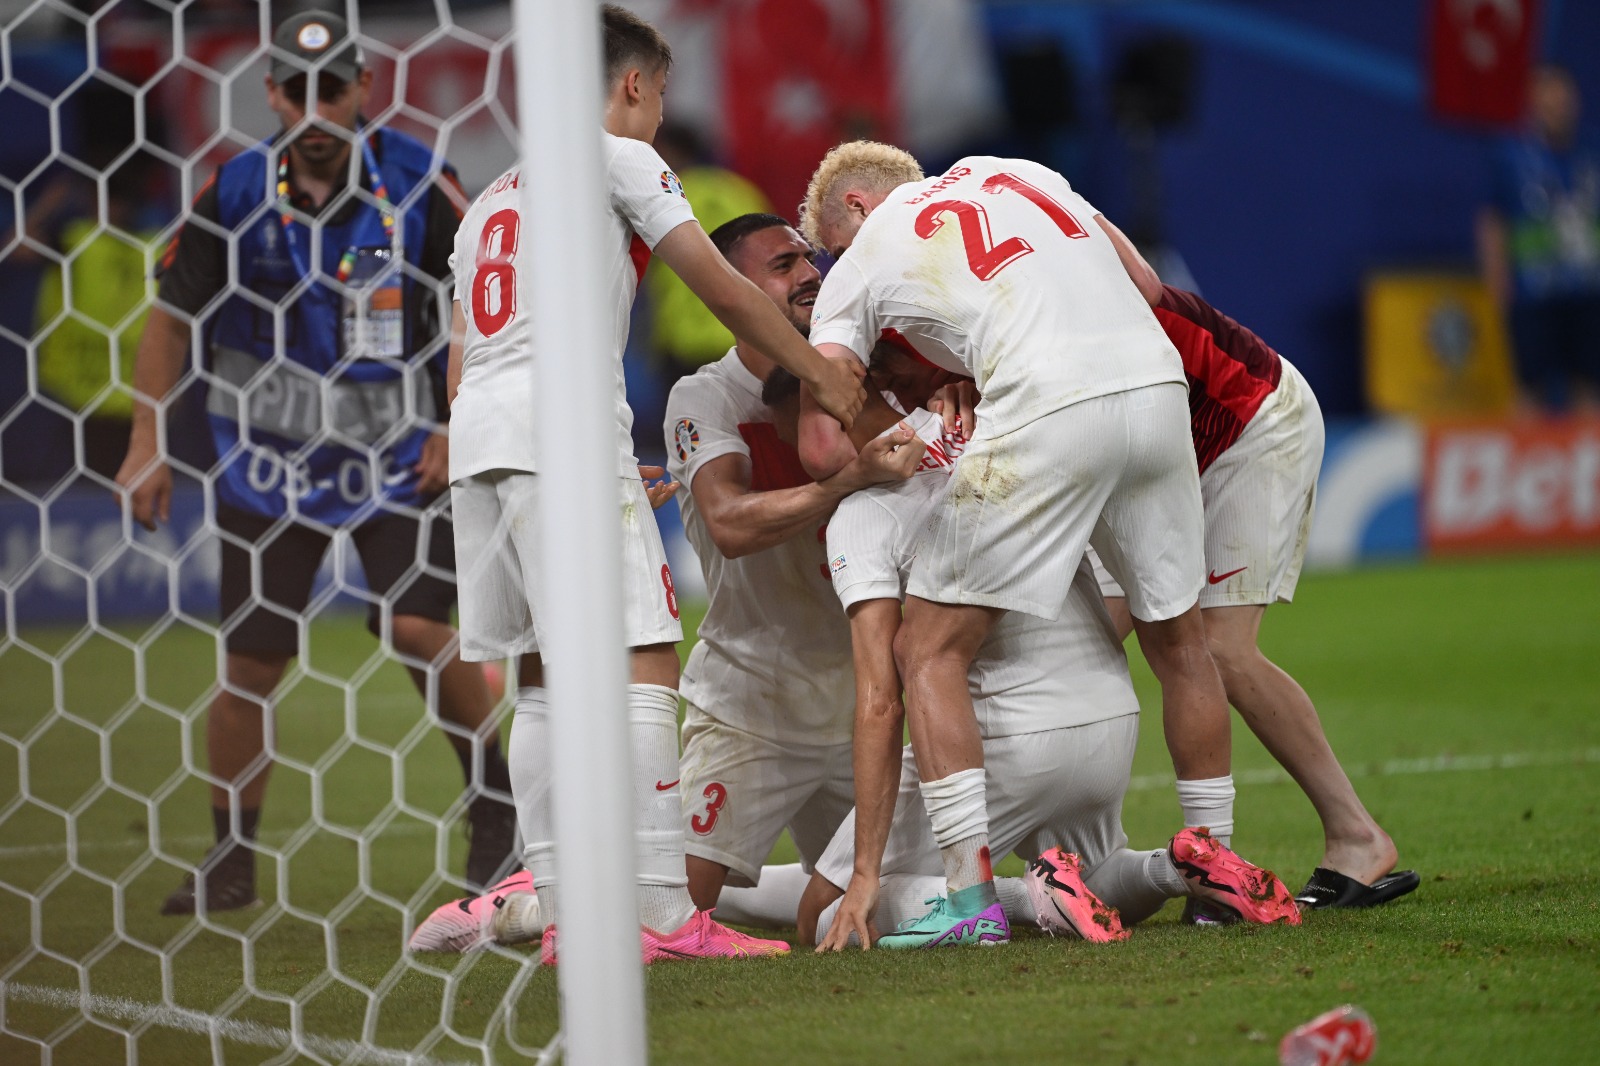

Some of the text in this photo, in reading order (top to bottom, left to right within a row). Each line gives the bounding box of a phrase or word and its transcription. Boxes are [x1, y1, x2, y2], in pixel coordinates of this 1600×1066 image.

[472, 208, 520, 338] 8
[914, 173, 1090, 281] 21
[691, 782, 727, 837] 3
